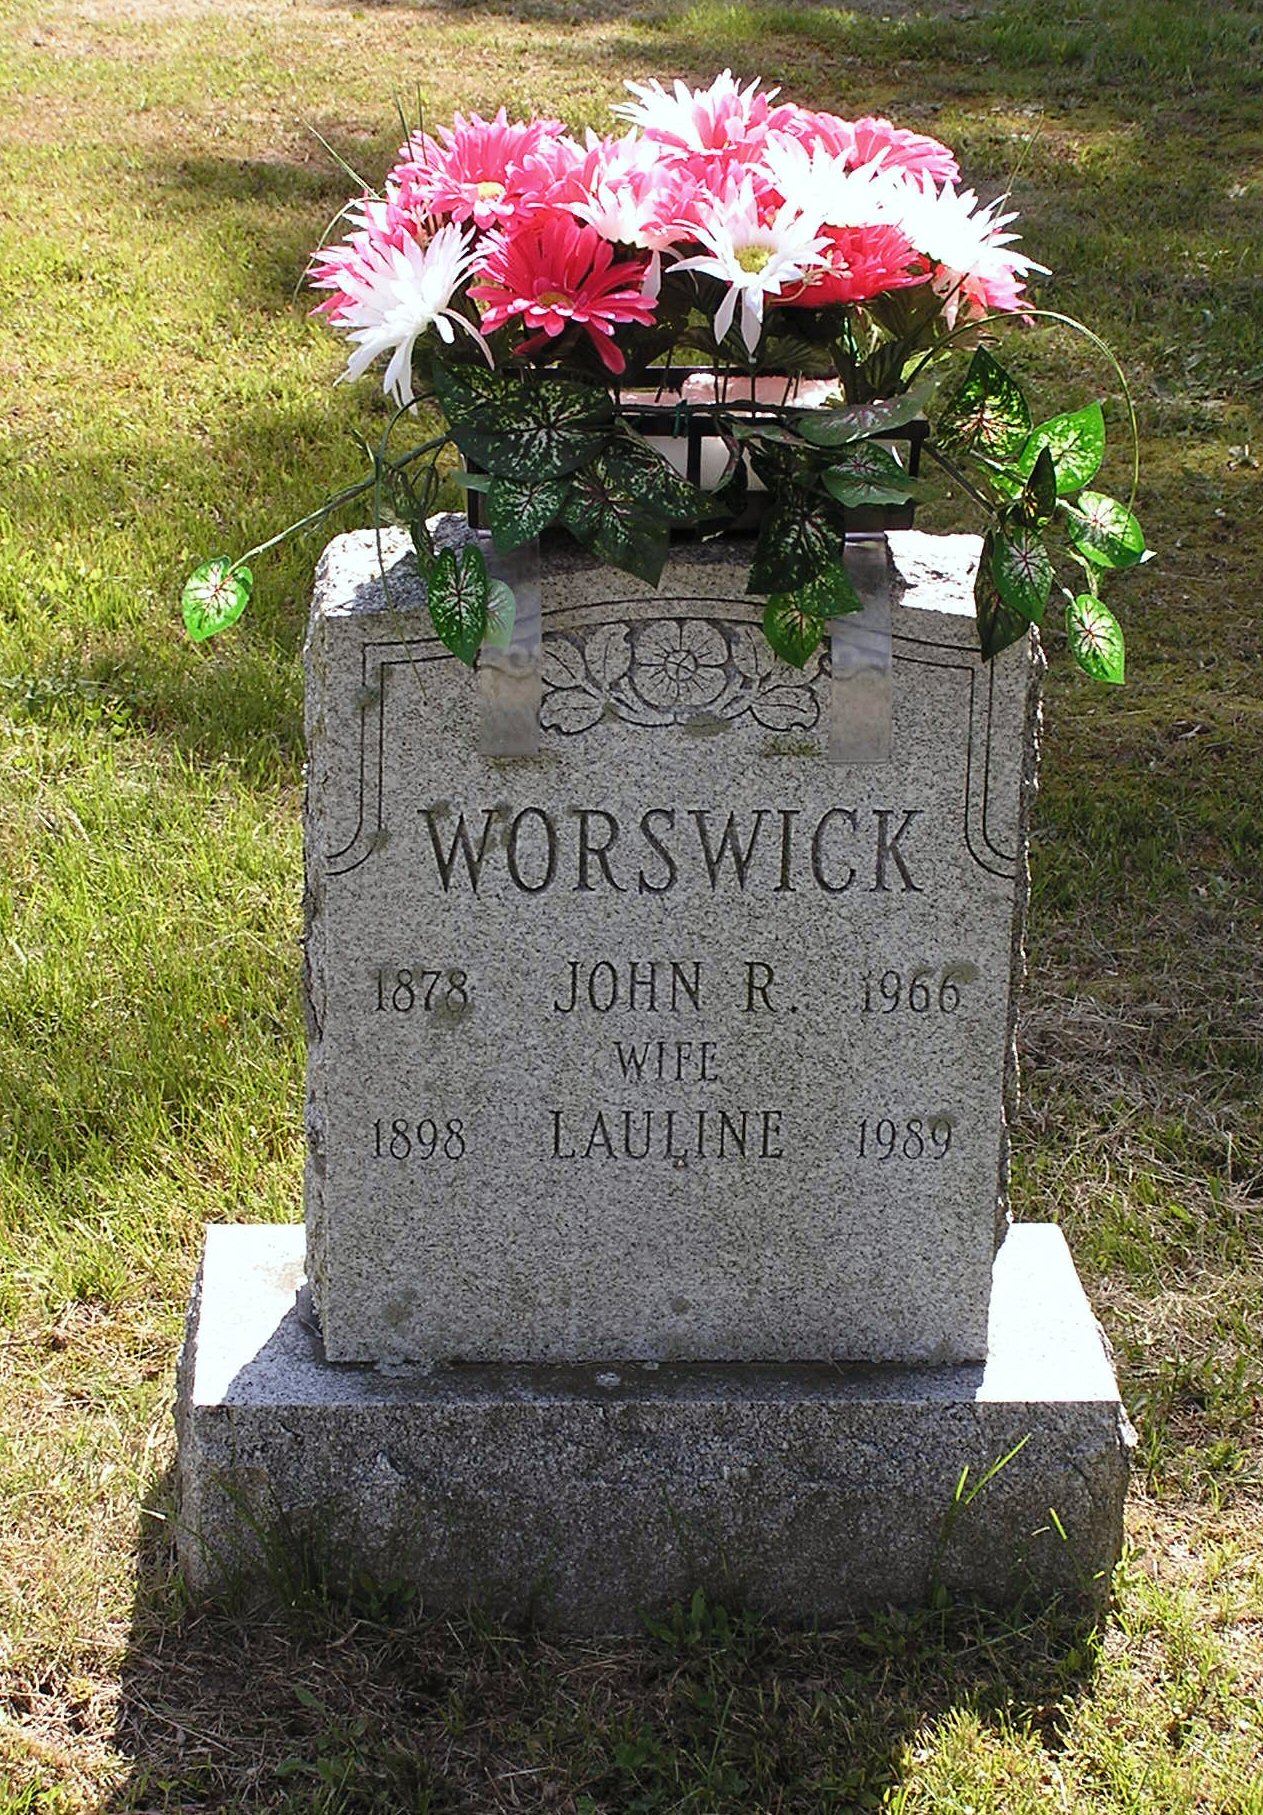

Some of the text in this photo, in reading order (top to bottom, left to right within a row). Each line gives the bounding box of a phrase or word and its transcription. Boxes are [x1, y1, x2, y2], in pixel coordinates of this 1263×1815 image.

[417, 807, 924, 894] WORSWICK
[375, 960, 962, 1014] 1878 JOHN R. 1966
[613, 1040, 719, 1083] WIFE
[372, 1109, 954, 1161] 1898 LAULINE 1989
